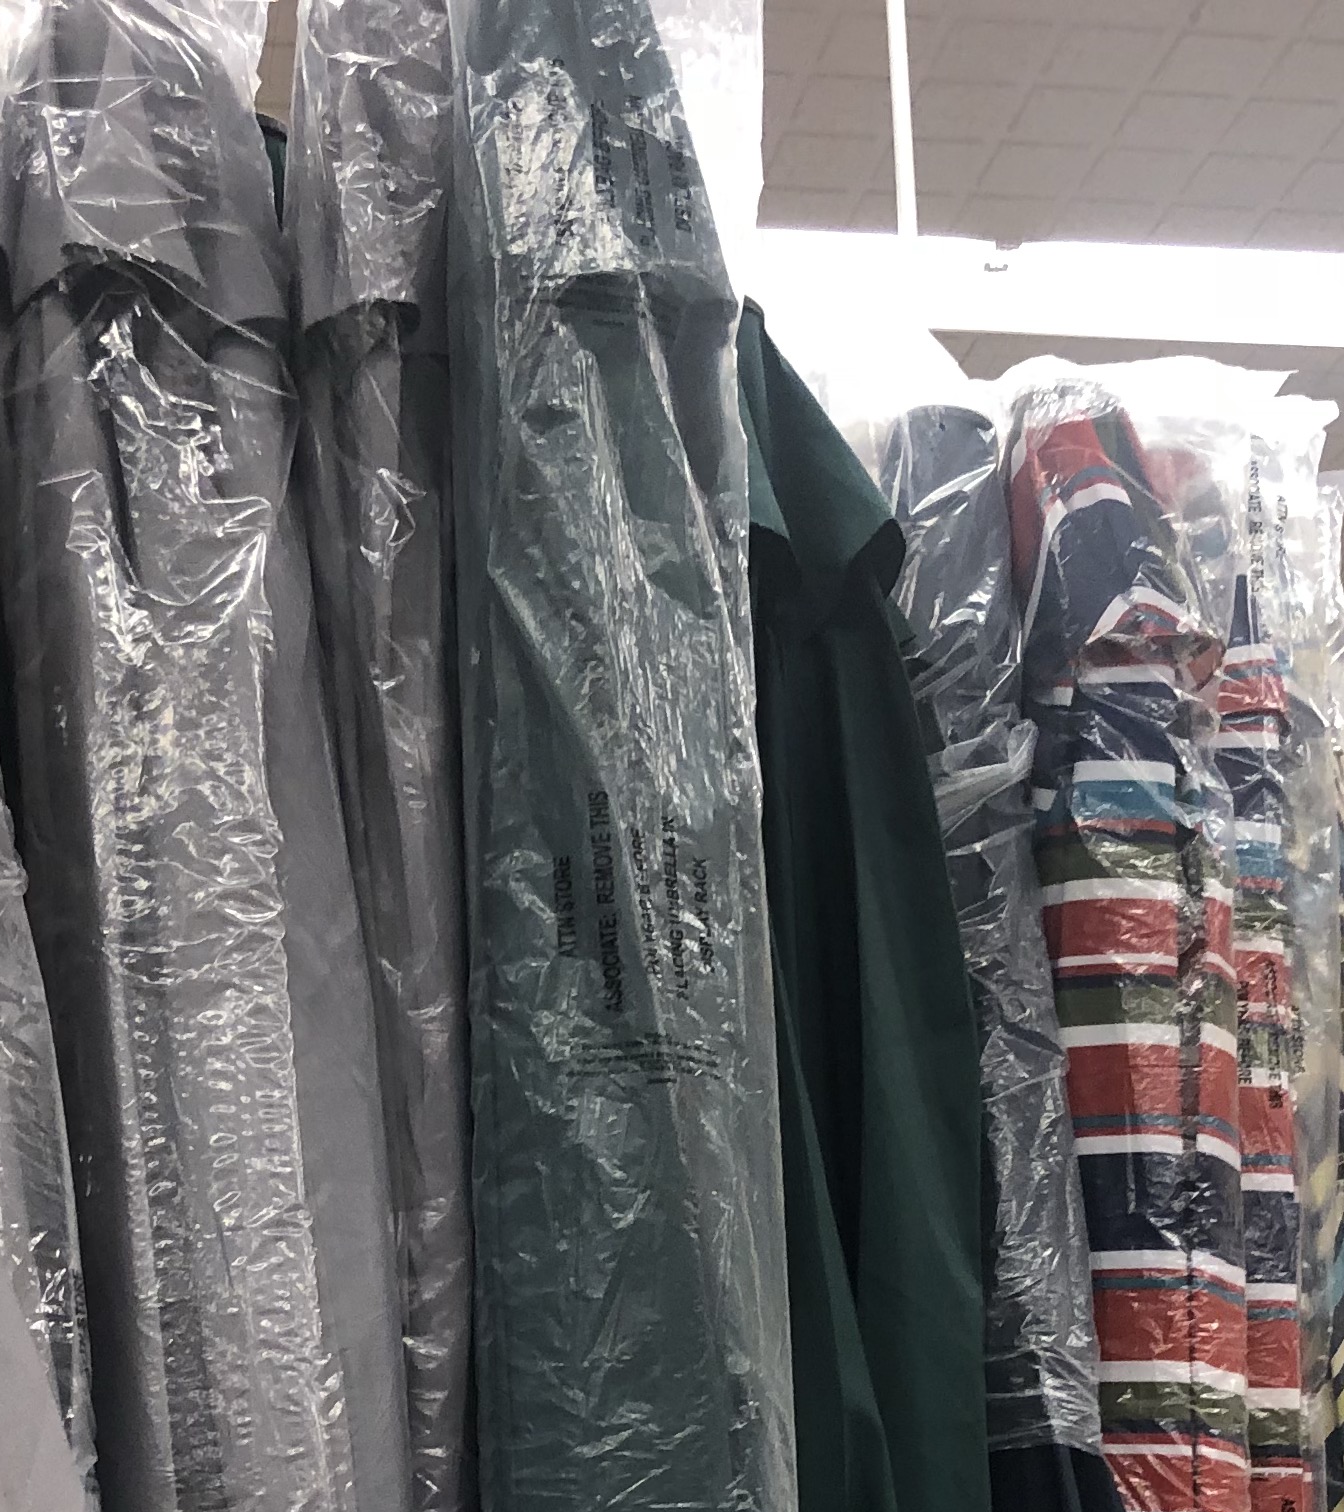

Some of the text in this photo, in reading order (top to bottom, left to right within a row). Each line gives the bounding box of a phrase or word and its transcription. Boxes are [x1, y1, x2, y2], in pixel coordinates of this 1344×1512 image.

[587, 789, 610, 830] THIS
[553, 854, 576, 913] STORE
[591, 831, 616, 906] REMOVE
[691, 856, 709, 904] RACK
